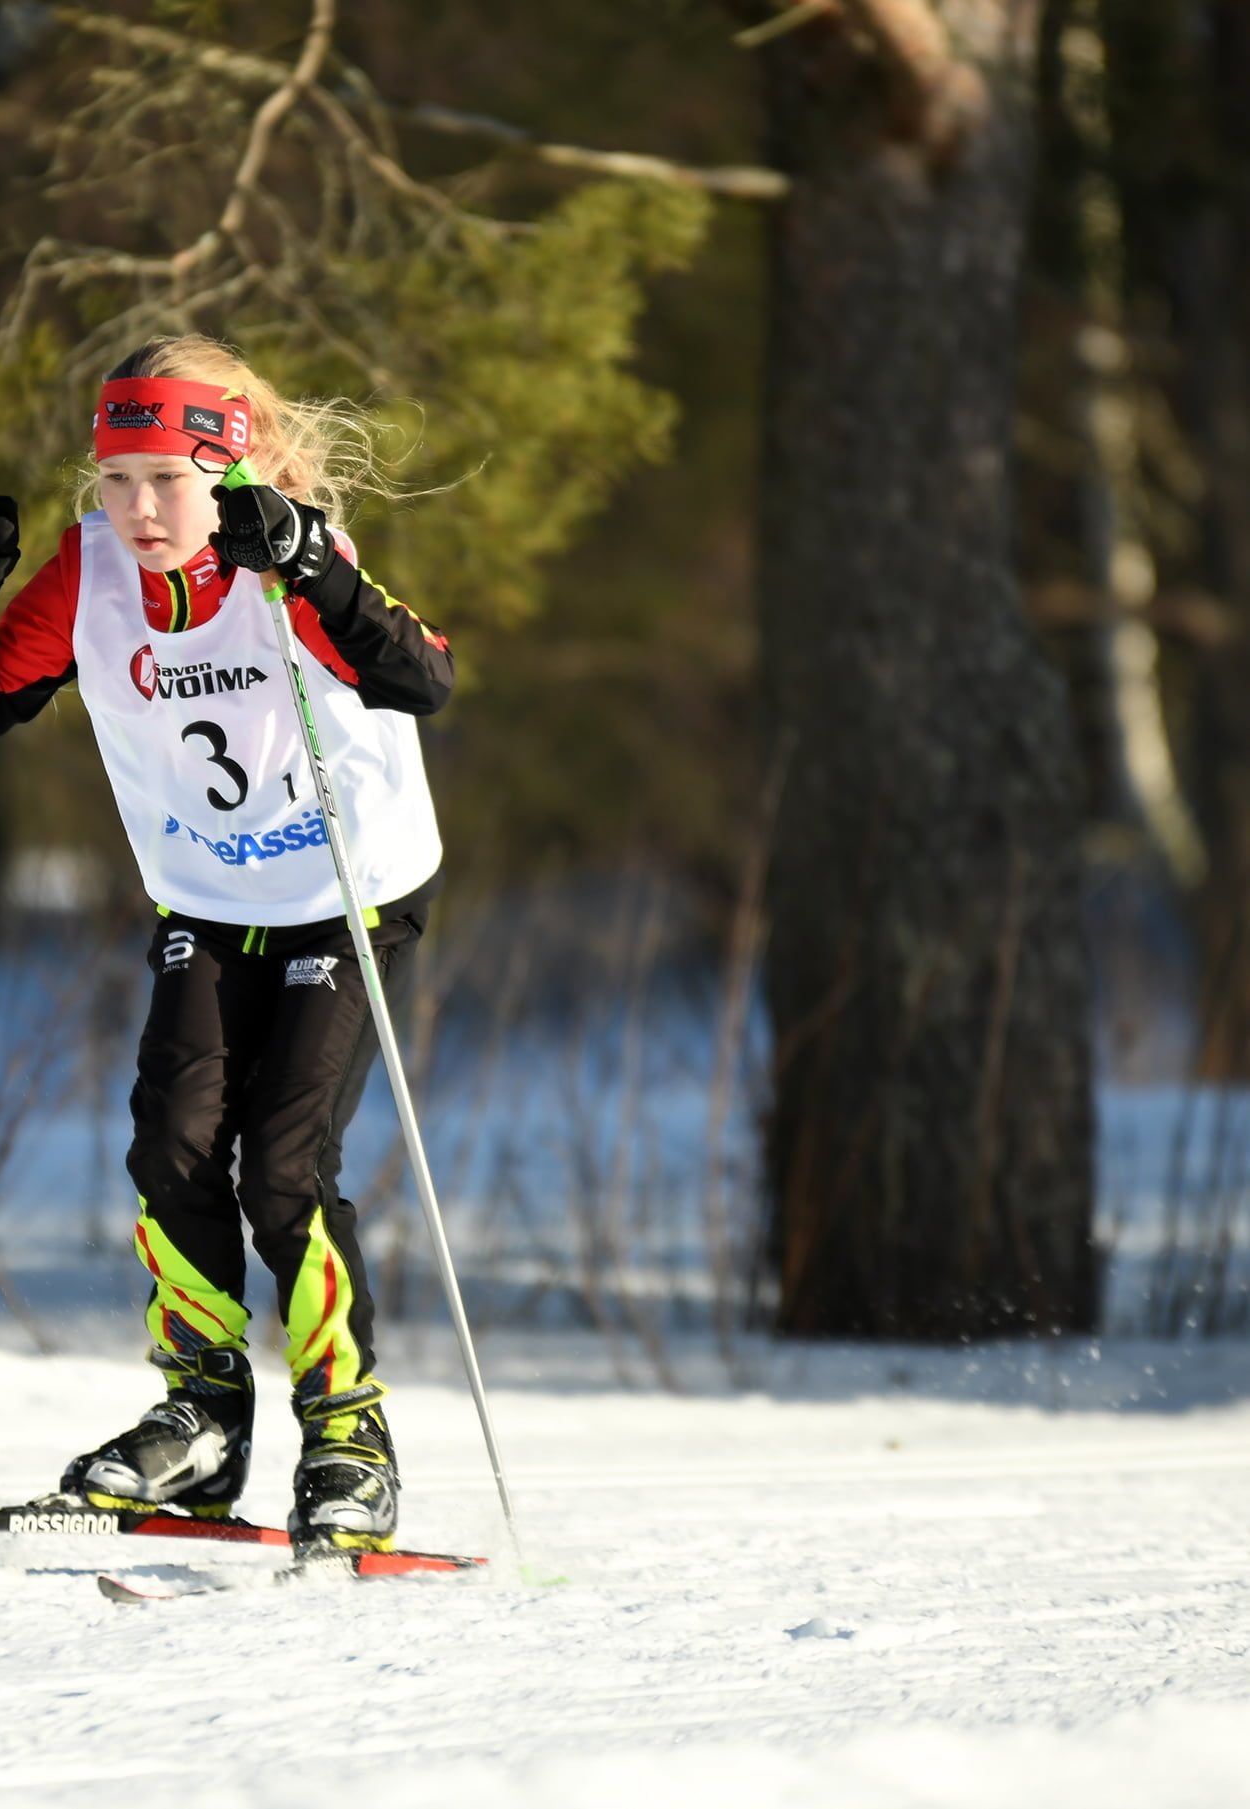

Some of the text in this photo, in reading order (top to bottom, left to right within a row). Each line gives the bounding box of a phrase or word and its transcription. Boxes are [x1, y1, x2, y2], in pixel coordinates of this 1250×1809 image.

[190, 413, 217, 428] Style
[181, 720, 249, 811] 3
[282, 772, 299, 807] 1
[9, 1513, 120, 1535] ROSSIGNOL
